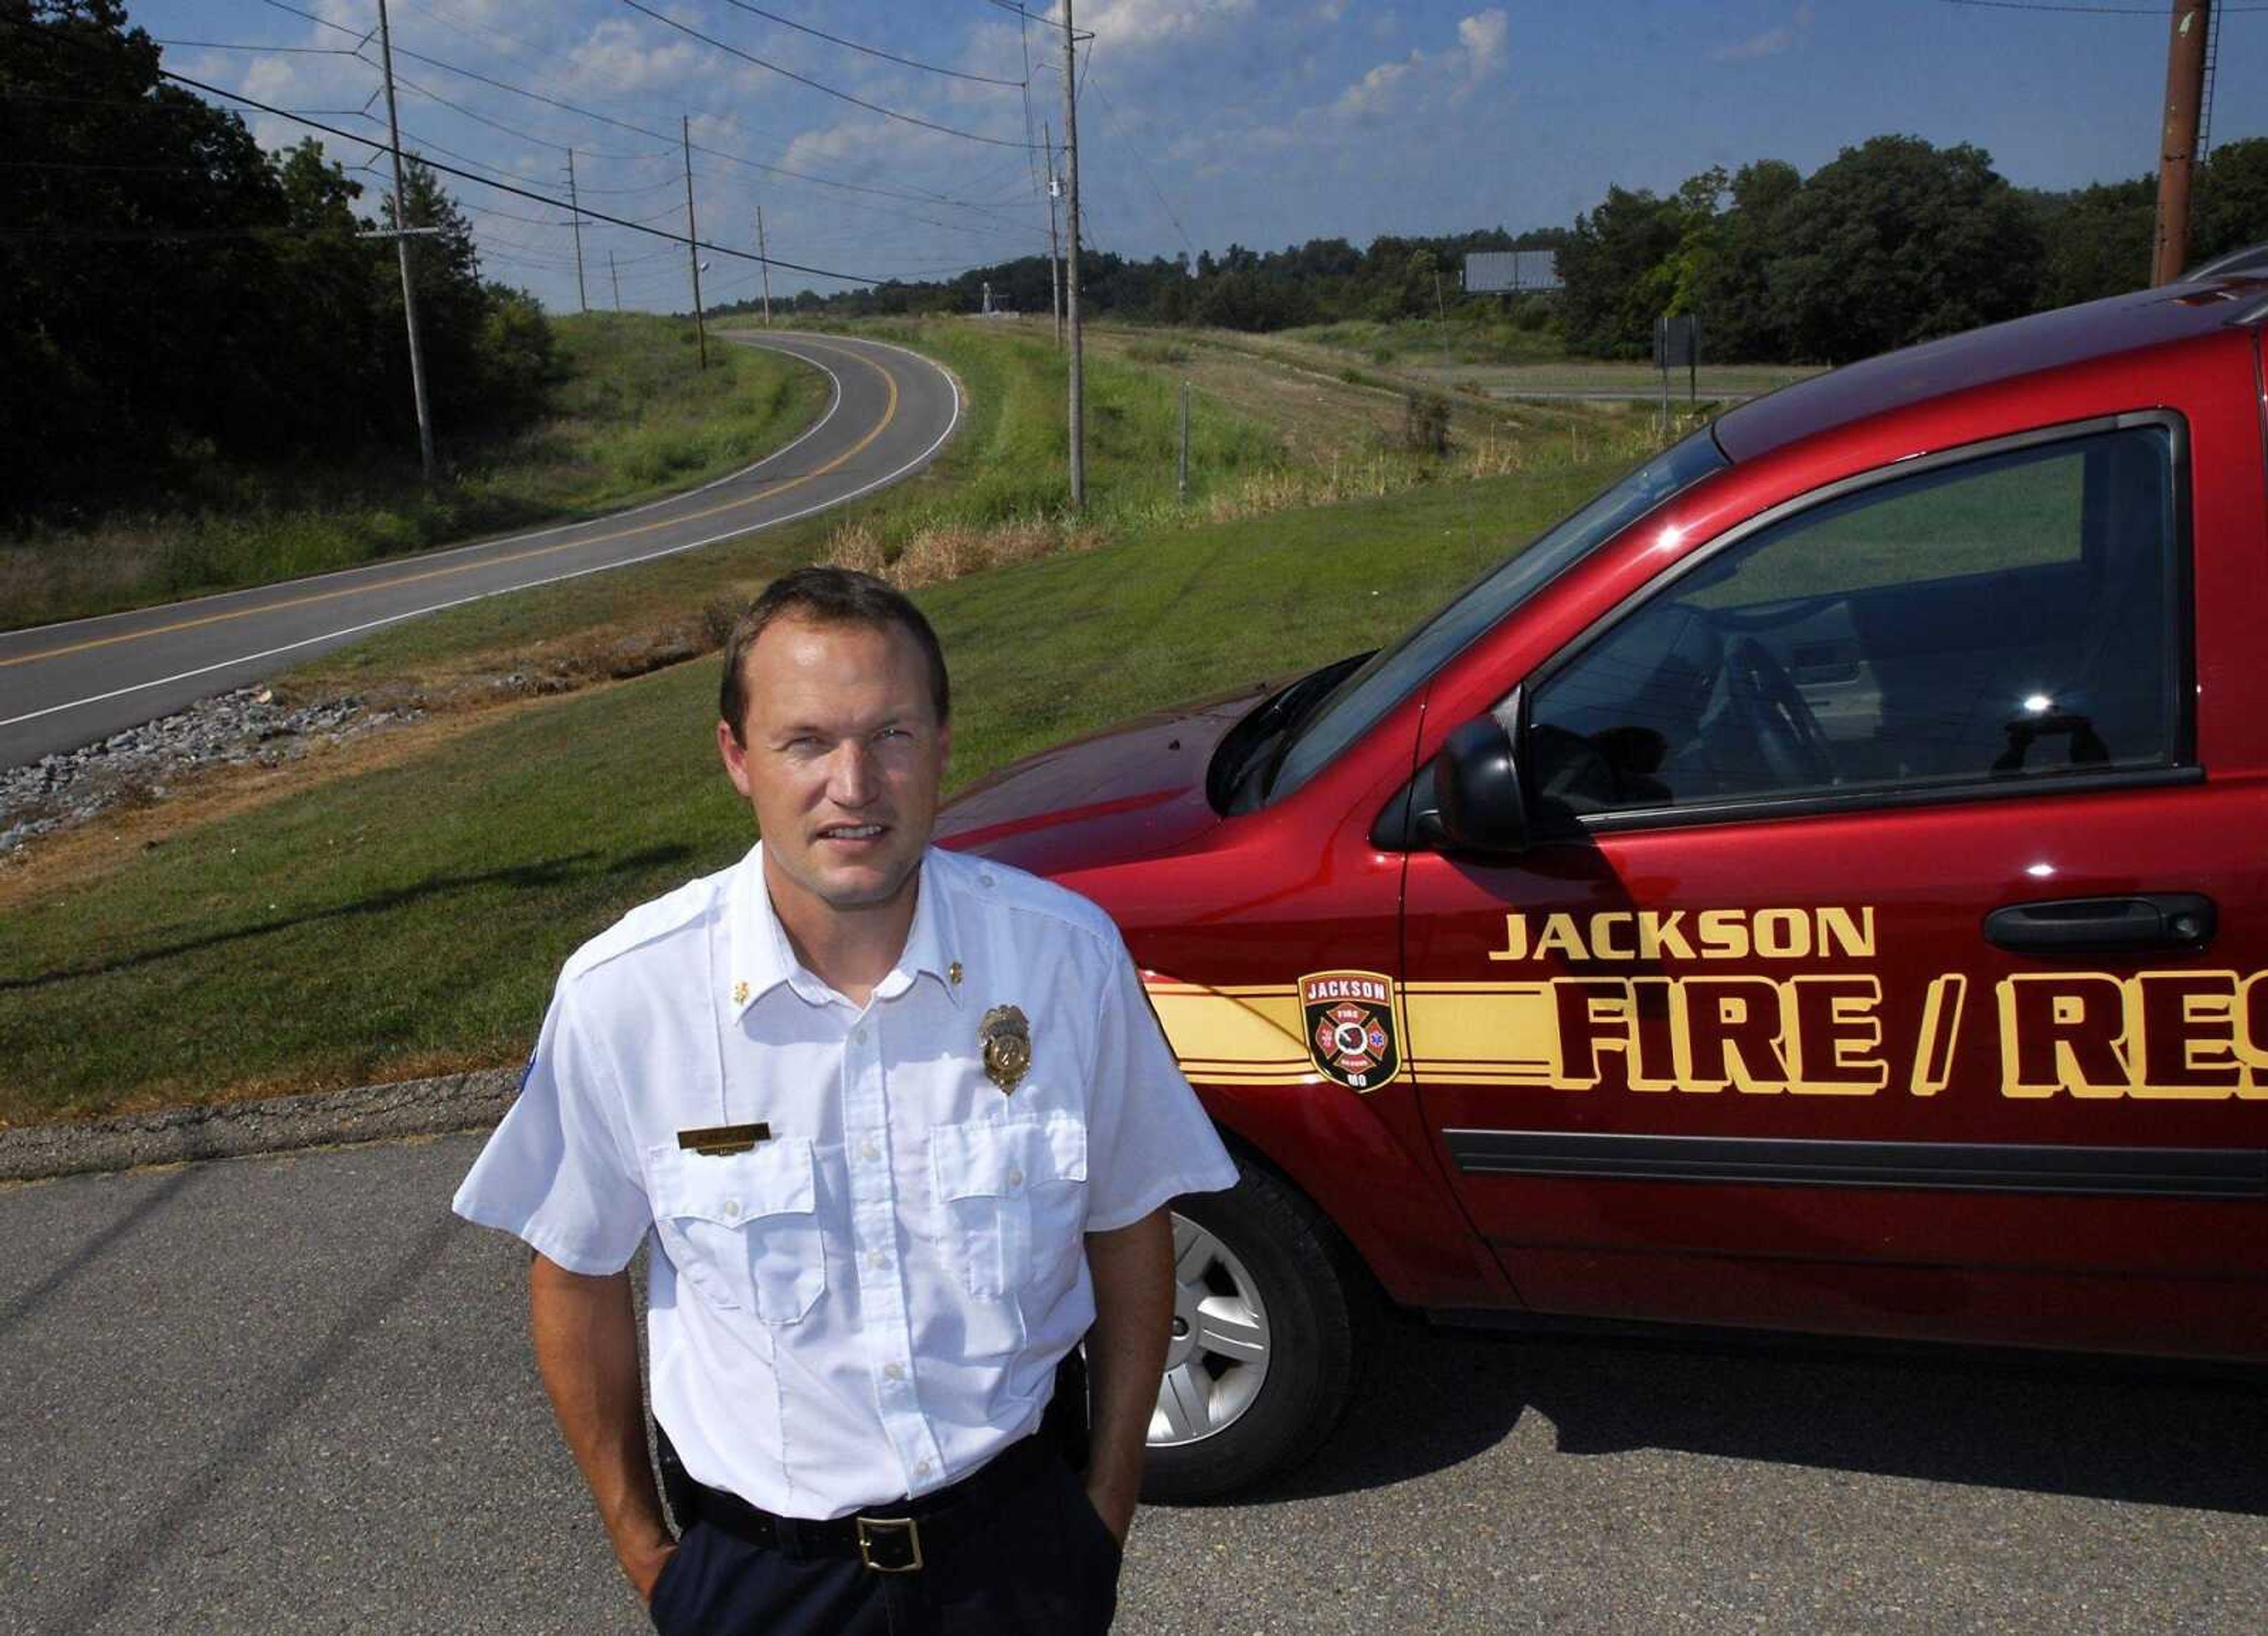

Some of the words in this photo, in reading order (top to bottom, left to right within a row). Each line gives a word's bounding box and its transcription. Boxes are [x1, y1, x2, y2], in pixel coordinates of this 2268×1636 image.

[1490, 908, 1875, 960] JACKSON
[1309, 981, 1384, 999] JACKSON
[1549, 976, 1888, 1094] FIRE
[1996, 970, 2268, 1099] RE
